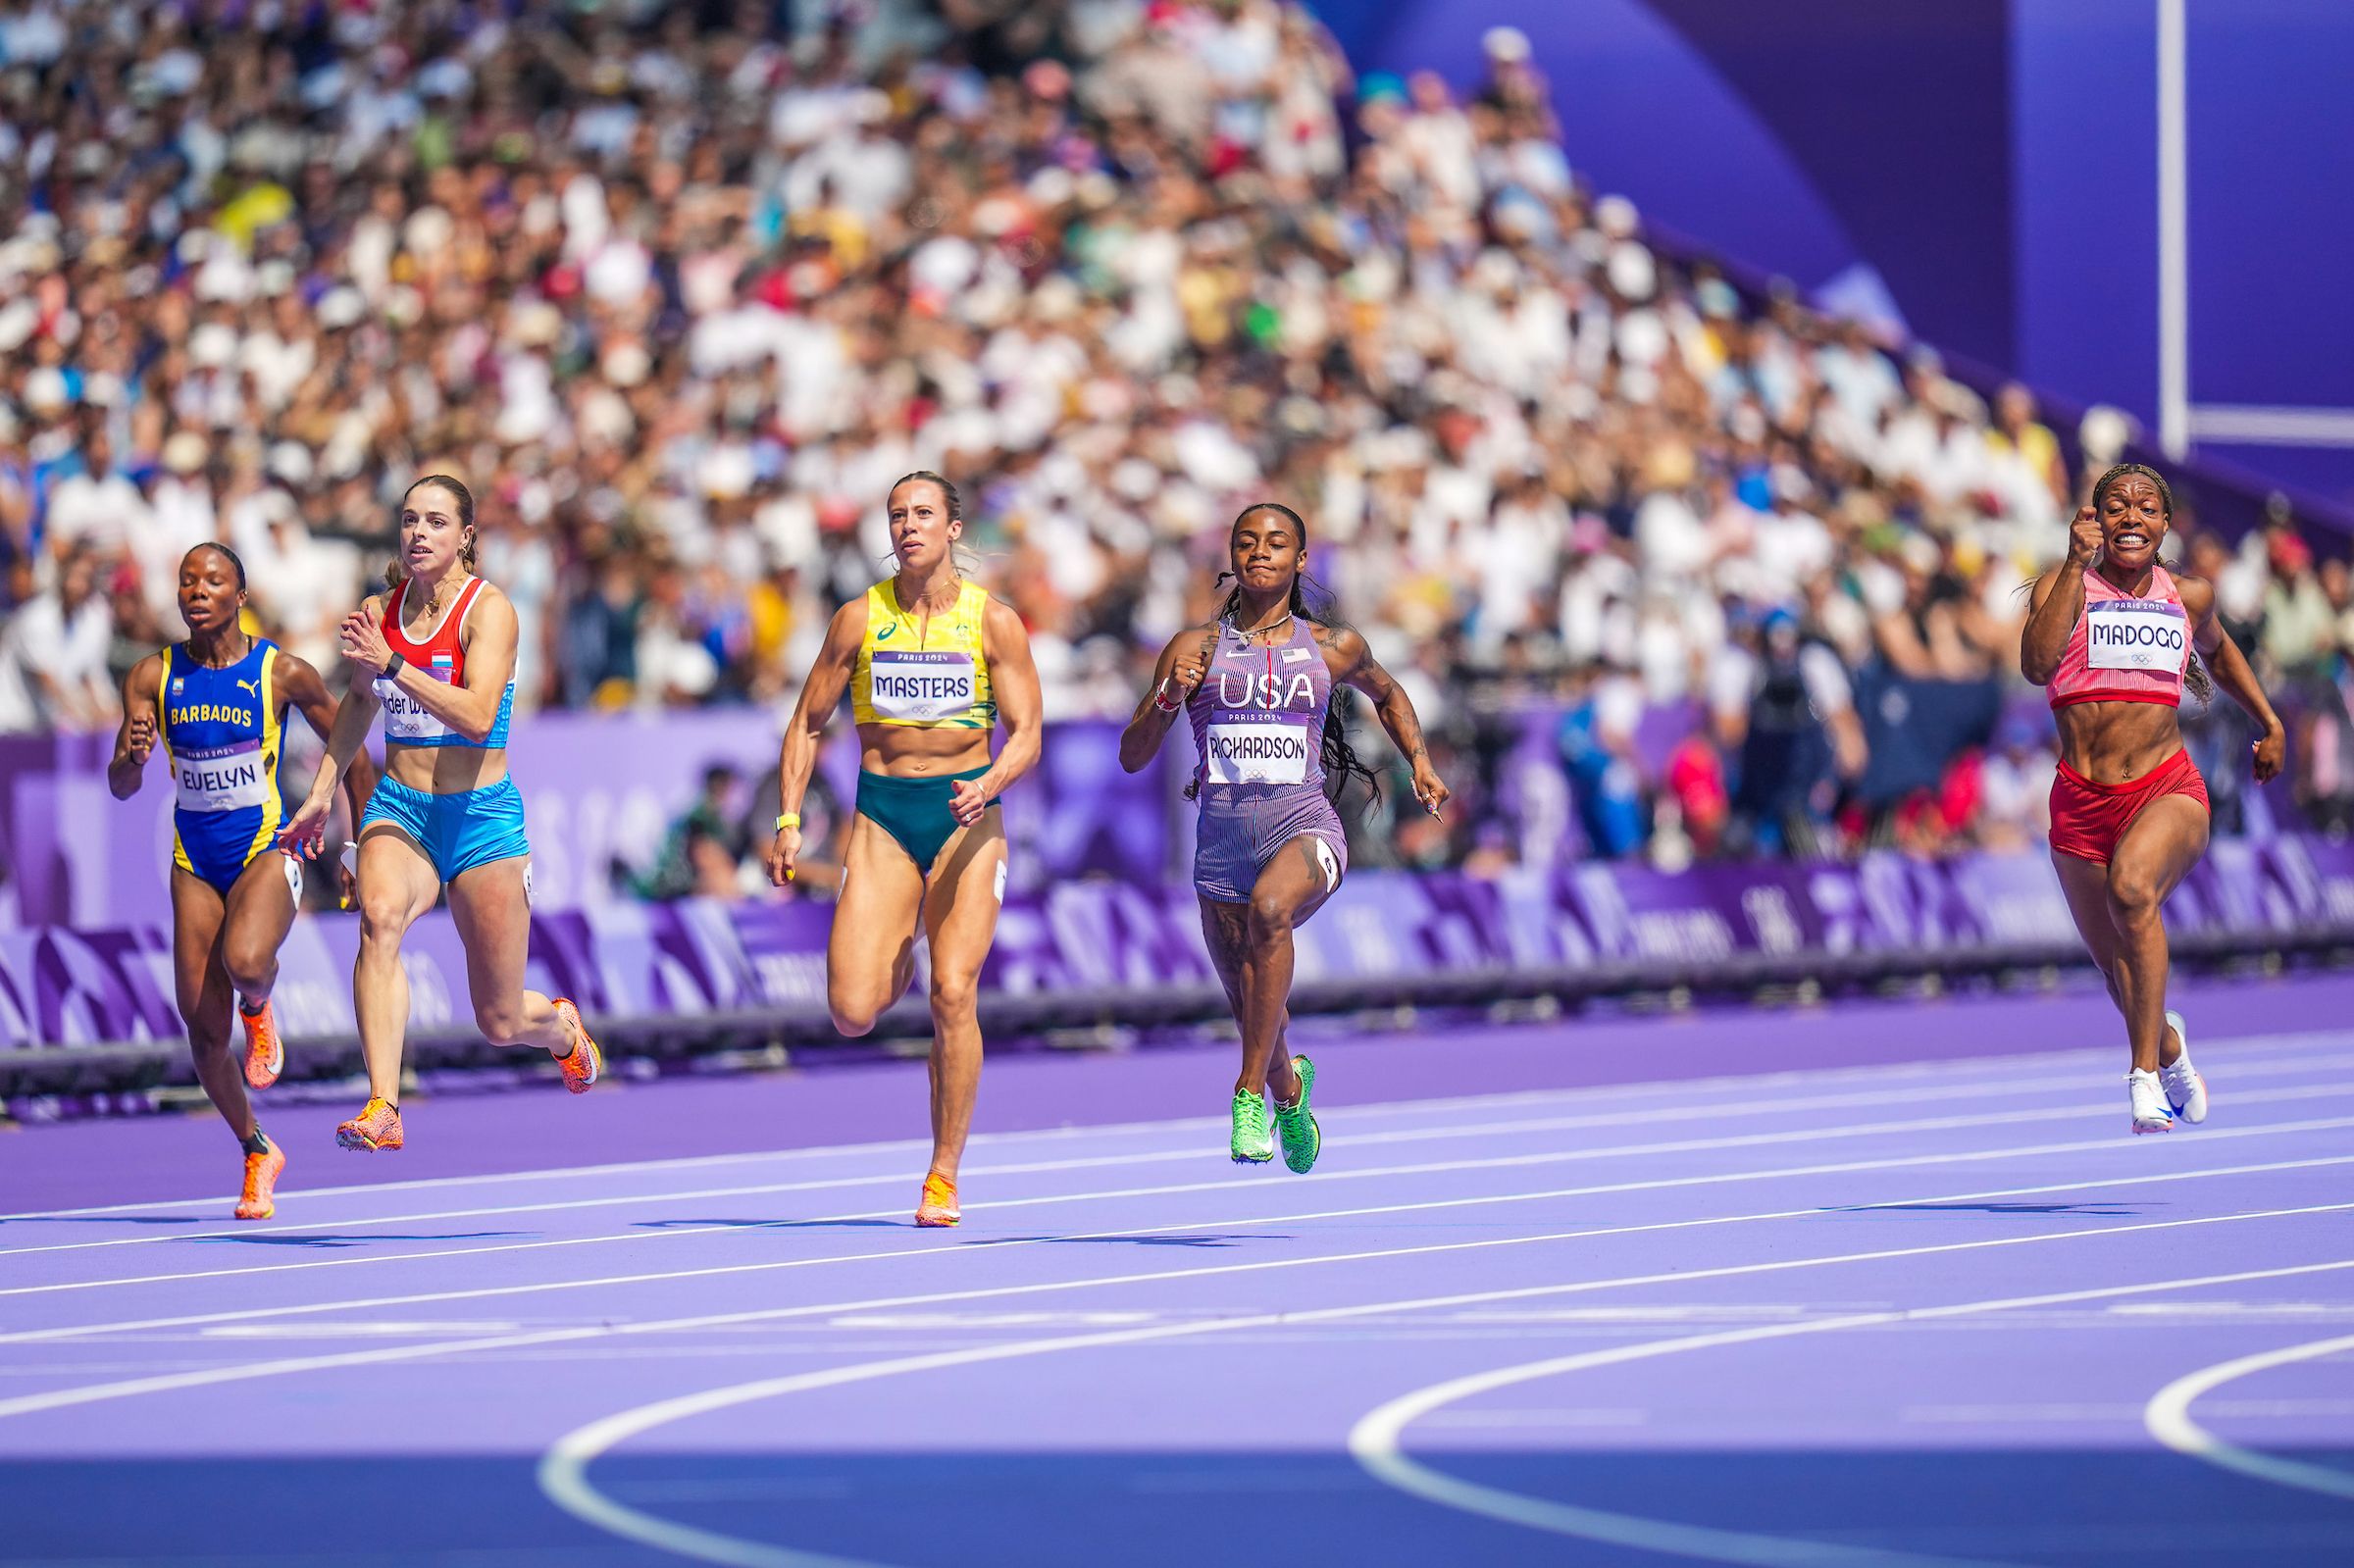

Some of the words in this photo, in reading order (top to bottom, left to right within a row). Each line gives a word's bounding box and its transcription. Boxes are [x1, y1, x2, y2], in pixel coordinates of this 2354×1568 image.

[2093, 624, 2182, 650] MADOGO
[897, 653, 923, 662] PARIS
[925, 653, 948, 662] 2024
[876, 676, 968, 698] MASTERS
[1219, 673, 1315, 709] USA
[171, 704, 252, 728] BARBADOS
[1209, 736, 1305, 759] RICHARDSON
